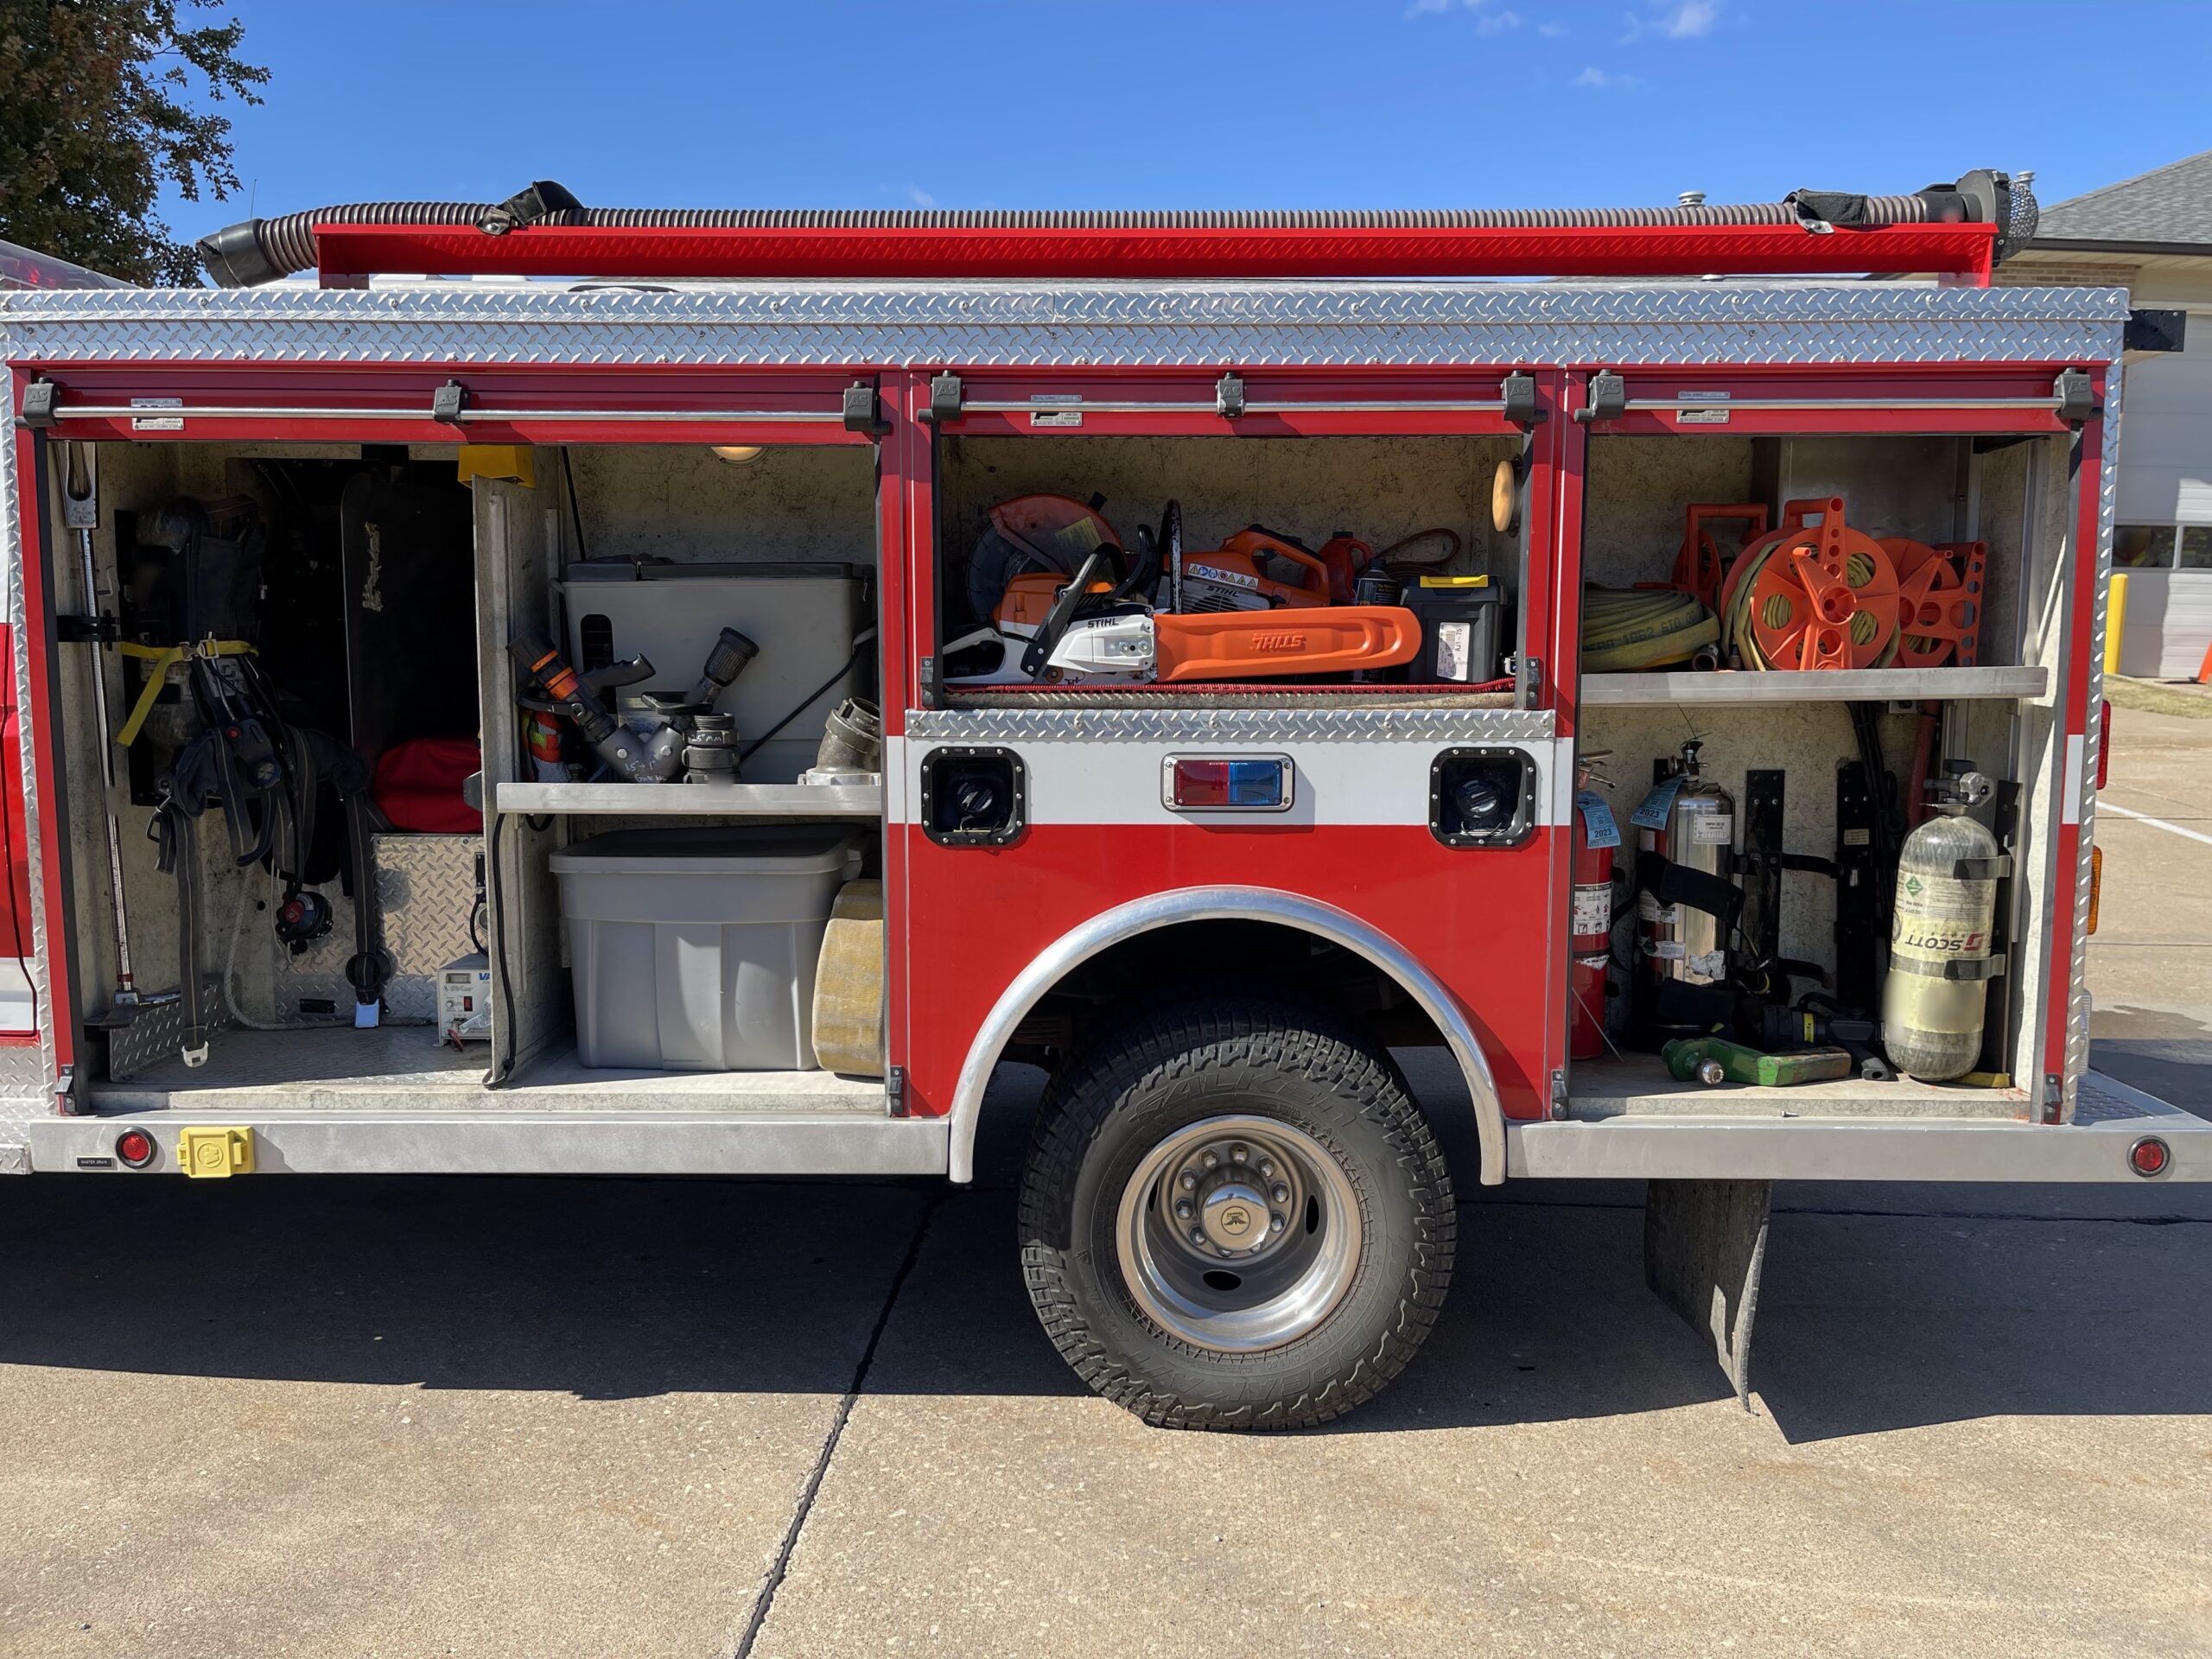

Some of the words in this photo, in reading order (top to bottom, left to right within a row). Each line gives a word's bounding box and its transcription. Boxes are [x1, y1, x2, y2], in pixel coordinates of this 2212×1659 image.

[937, 383, 957, 397] AS
[1510, 383, 1530, 397] AS
[28, 391, 48, 404] AS
[848, 394, 868, 408] AS
[1206, 585, 1240, 598] STIHL
[1087, 617, 1120, 629] STIHL
[1252, 635, 1306, 650] STIHL
[1639, 808, 1660, 818] 2023
[1594, 829, 1612, 838] 2023
[1904, 934, 1964, 951] SCOTT
